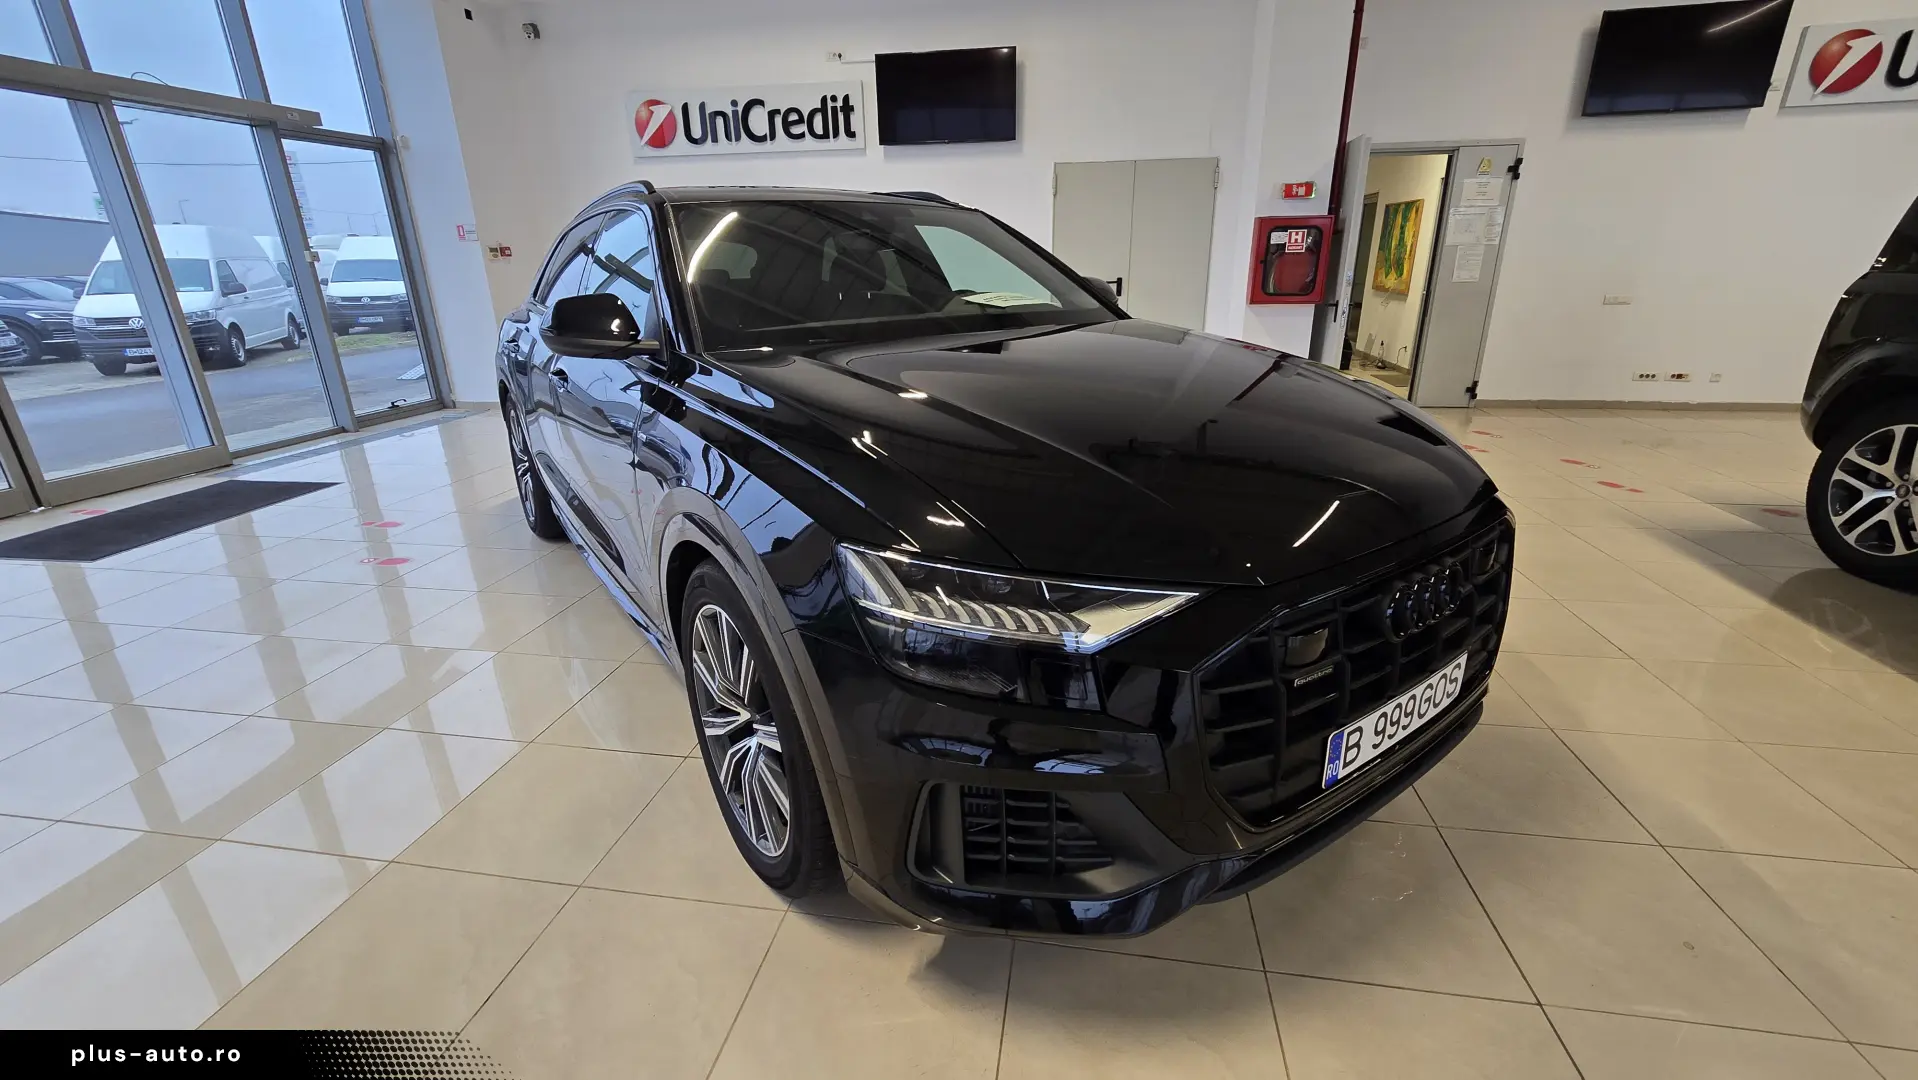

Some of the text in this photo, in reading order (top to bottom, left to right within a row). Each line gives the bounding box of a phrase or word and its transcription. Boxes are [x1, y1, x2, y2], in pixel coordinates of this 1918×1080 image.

[682, 93, 856, 146] UniCredit
[1290, 232, 1303, 244] H
[1294, 665, 1334, 687] quattro
[1341, 725, 1364, 771] B
[1326, 760, 1339, 780] RO
